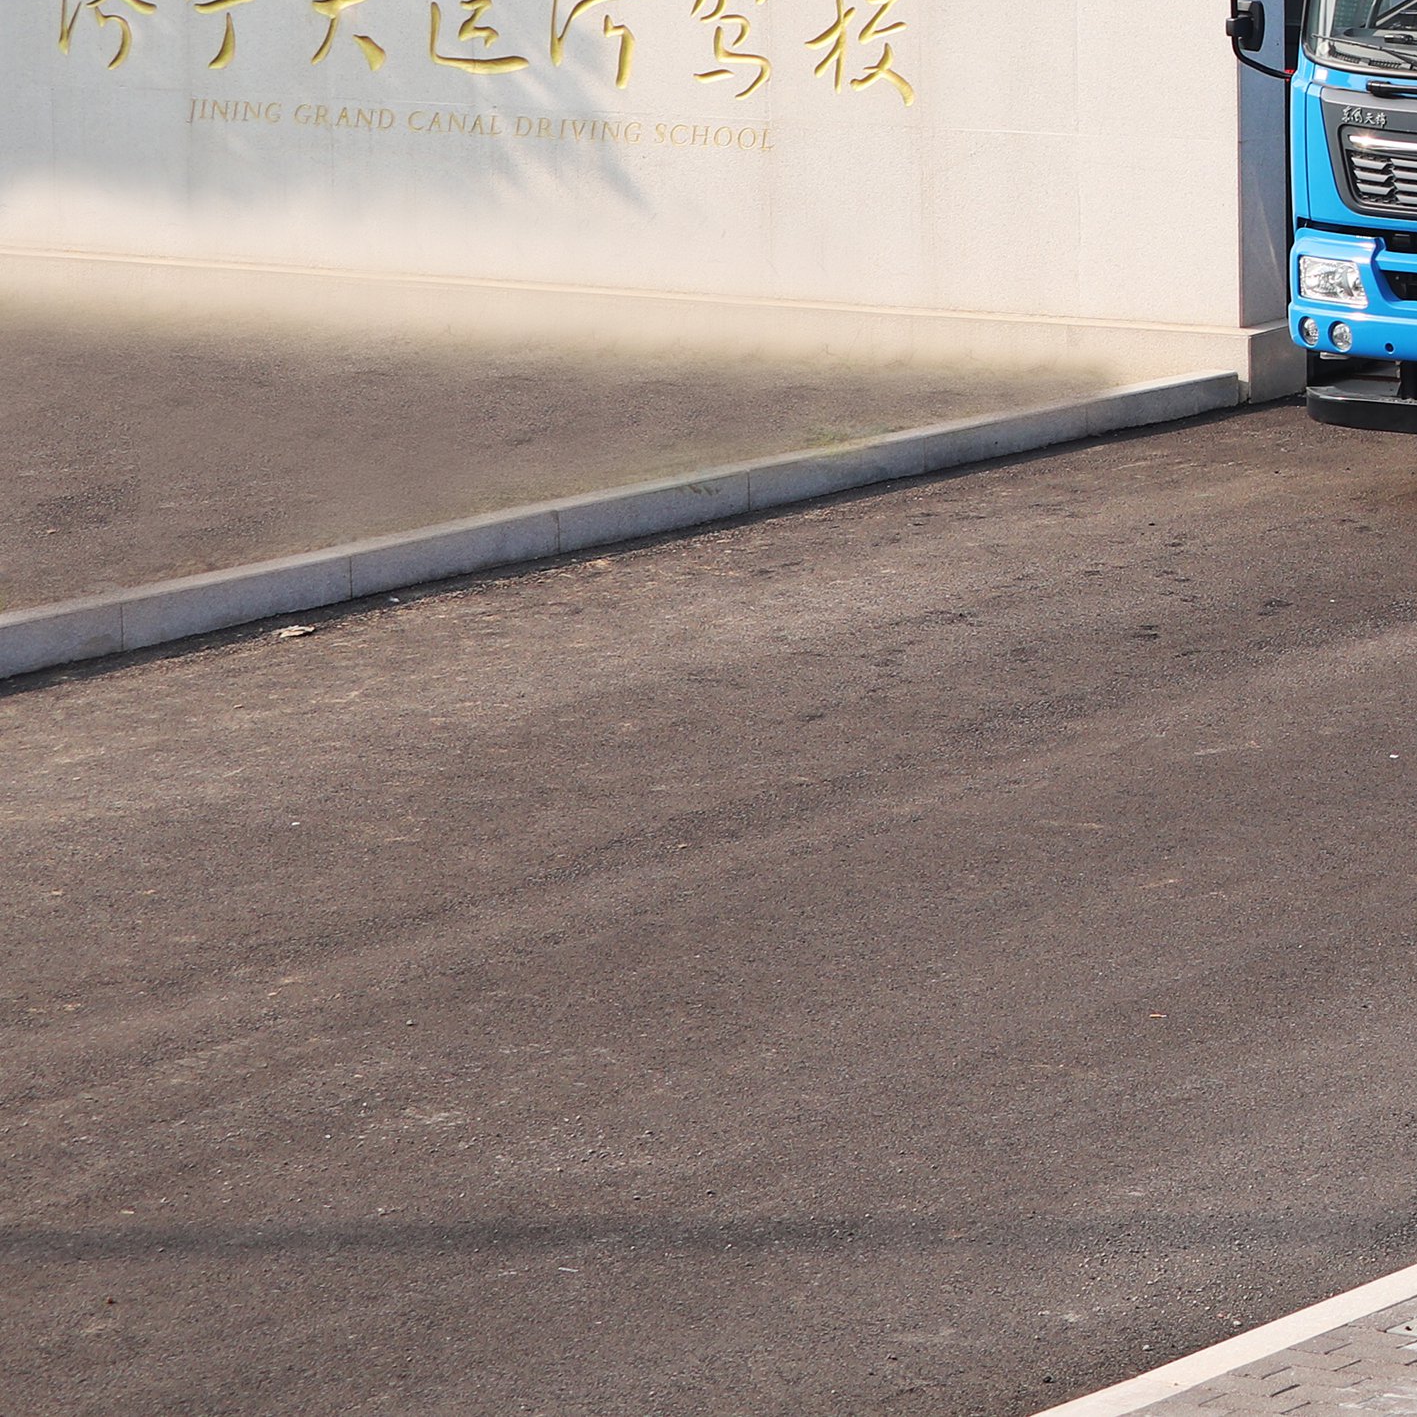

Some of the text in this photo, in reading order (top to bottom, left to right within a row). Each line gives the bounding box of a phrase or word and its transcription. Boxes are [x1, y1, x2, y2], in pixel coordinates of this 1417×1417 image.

[186, 98, 777, 151] JINING GRAND CANAL DRIVING SCHOOL
